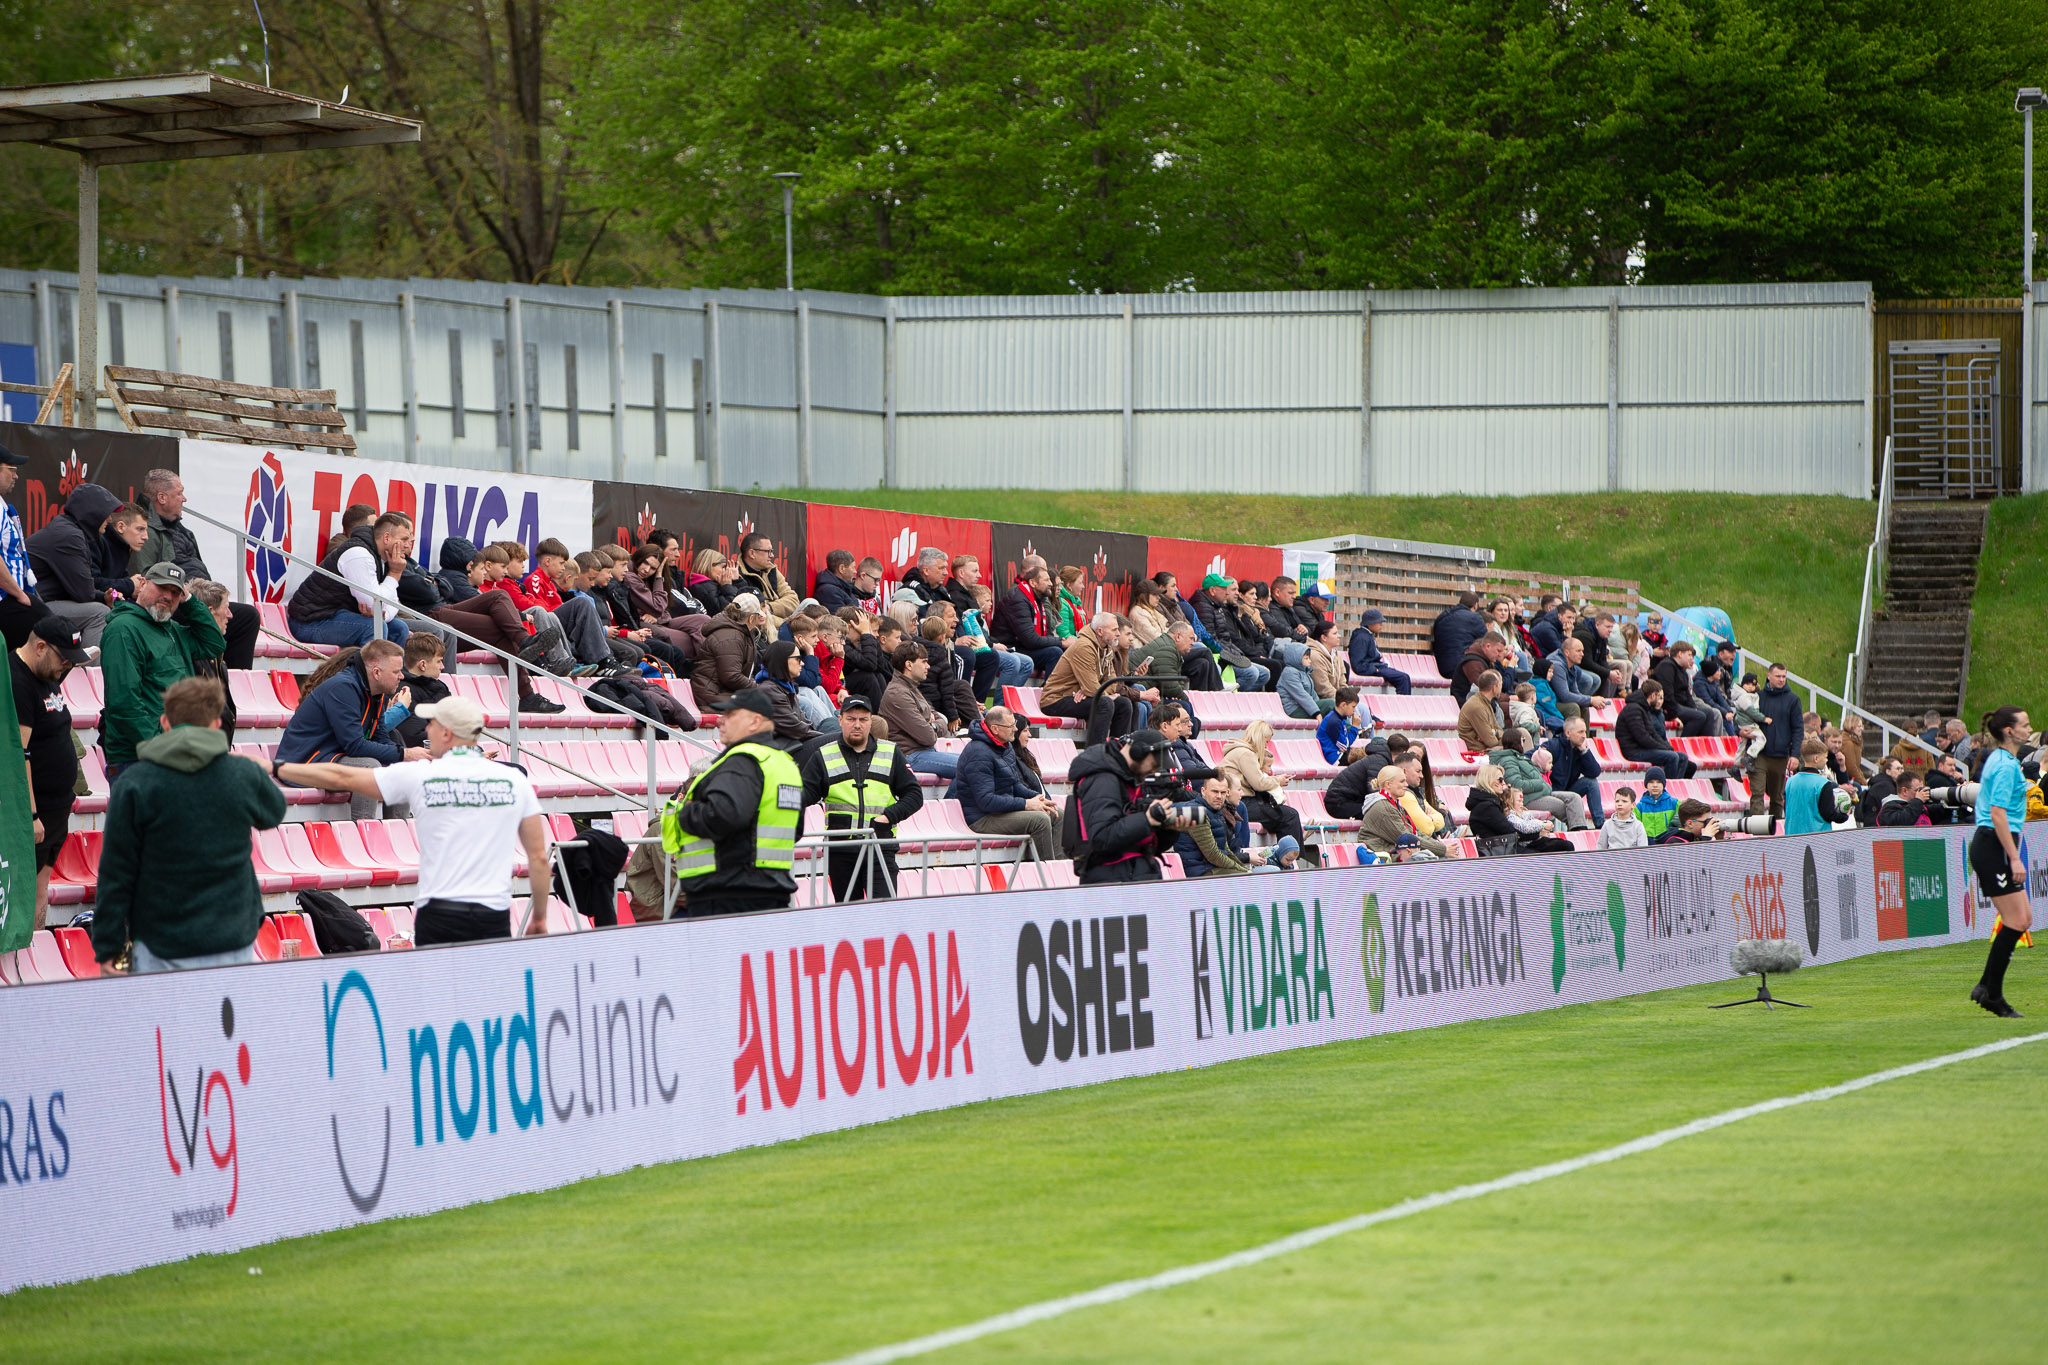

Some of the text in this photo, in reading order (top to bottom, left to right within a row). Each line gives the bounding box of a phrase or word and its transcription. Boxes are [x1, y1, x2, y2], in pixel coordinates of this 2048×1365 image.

[1392, 891, 1525, 998] KELRANGA
[1879, 871, 1903, 910] STIHL
[733, 929, 974, 1116] AUTOTOJA
[1016, 914, 1155, 1066] OSHEE
[1213, 898, 1335, 1036] VIDARA
[408, 956, 678, 1146] nordclinic
